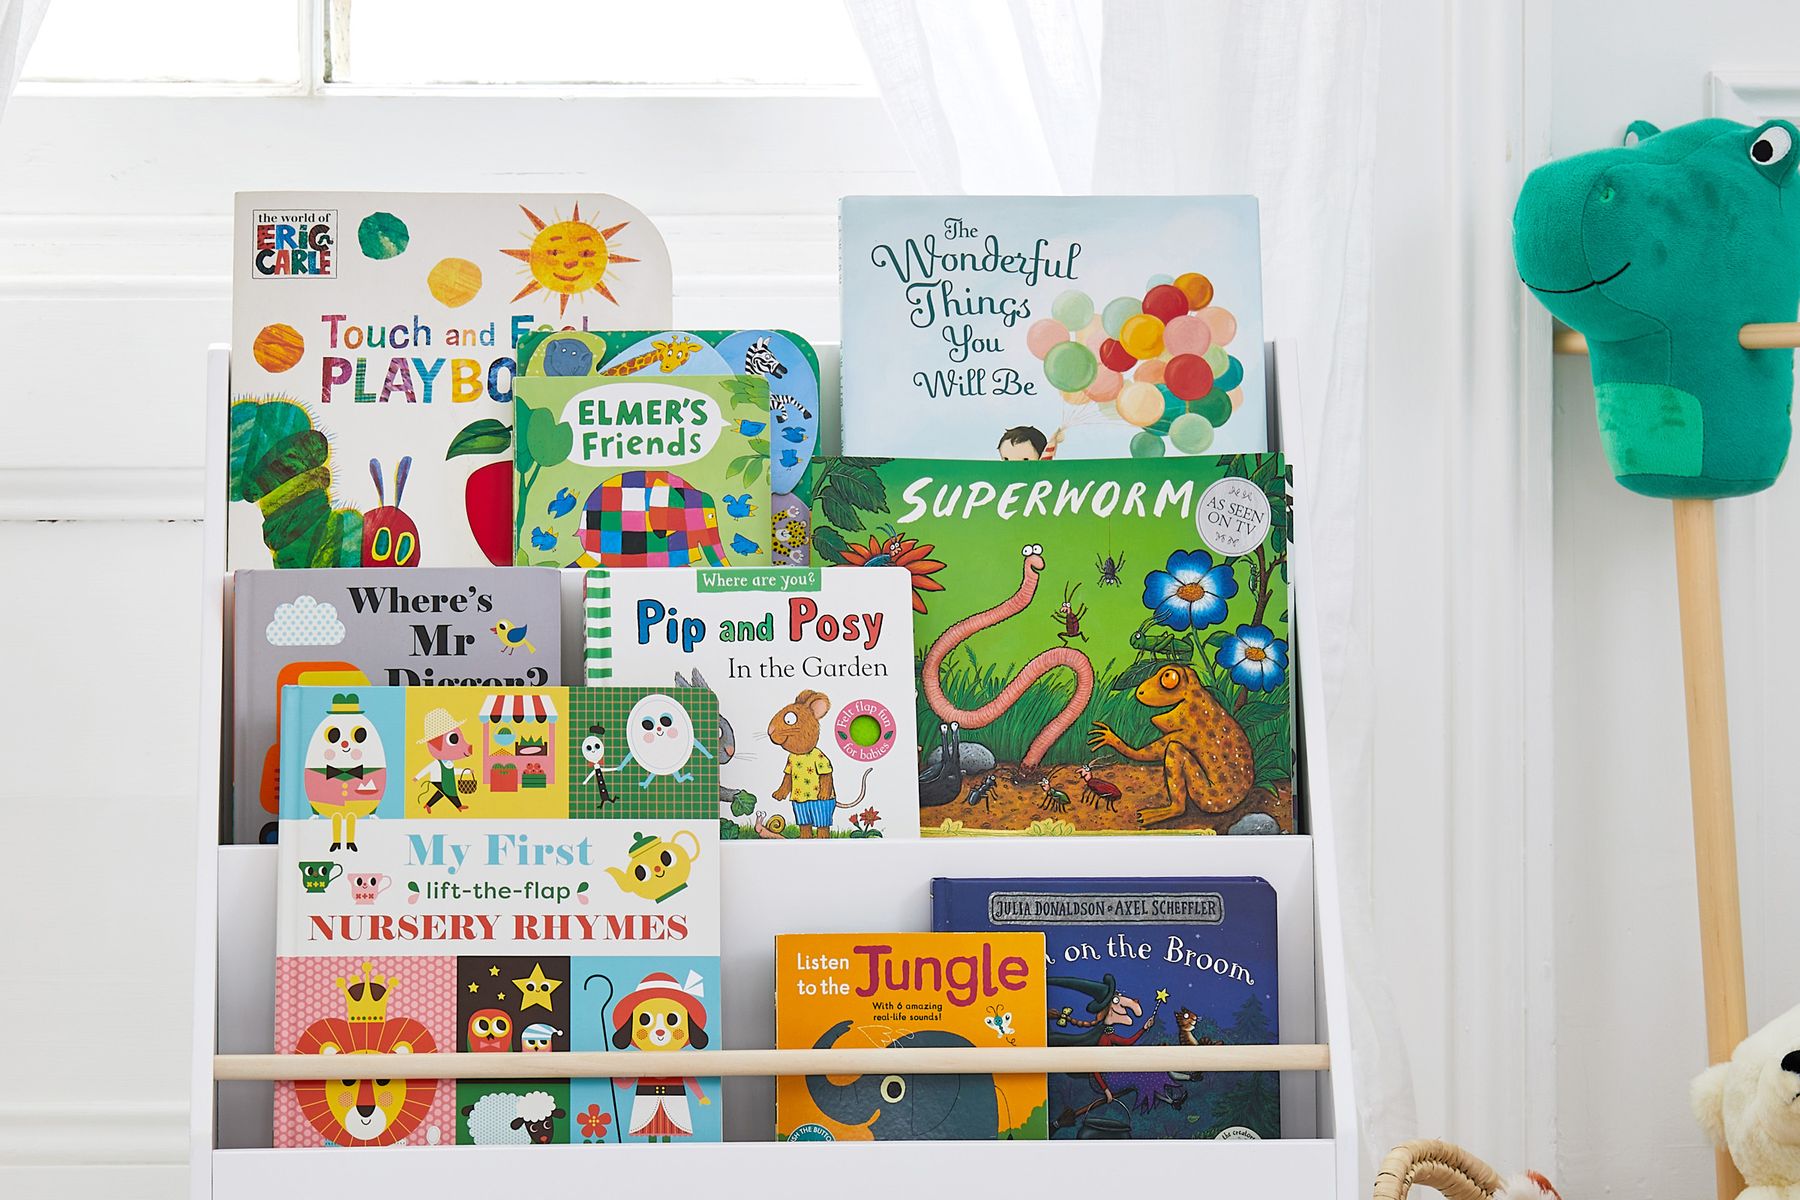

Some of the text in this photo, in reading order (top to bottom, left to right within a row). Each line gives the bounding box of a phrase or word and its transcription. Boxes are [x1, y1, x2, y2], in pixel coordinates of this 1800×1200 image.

[259, 213, 331, 222] the world of
[944, 217, 978, 240] The
[256, 249, 330, 275] CARLE
[871, 235, 1081, 286] Wonderful
[906, 279, 1031, 328] Things
[321, 315, 431, 349] Touch
[445, 322, 495, 346] and
[942, 325, 1004, 363] You
[913, 368, 1037, 398] Will Be
[579, 398, 708, 426] ELMER'S
[582, 427, 701, 460] Friends
[897, 477, 1194, 524] SUPERWORM
[1207, 497, 1264, 523] AS SEEN
[1208, 511, 1256, 535] ON TV
[702, 572, 816, 590] Where are you?
[347, 586, 493, 613] Where's
[637, 597, 884, 653] Pip and Posy
[409, 624, 475, 656] Mr
[728, 655, 889, 678] In the Garden
[837, 701, 891, 728] Felt flap fun
[844, 743, 890, 759] for babies
[404, 833, 595, 875] My First
[426, 881, 571, 904] lift-the-flap
[996, 899, 1217, 918] JULIA DONALDSON AXEL SCHEFFLER
[308, 914, 689, 941] NURSERY RHYMES
[797, 953, 849, 970] Listen
[1065, 943, 1101, 962] on
[1107, 934, 1151, 959] the
[1164, 935, 1255, 986] Broom
[797, 977, 850, 995] to the
[853, 942, 1029, 1007] Jungle
[872, 1002, 943, 1013] With 6 amazing
[873, 1013, 942, 1022] real-life sounds!
[799, 1126, 812, 1134] THE
[813, 1126, 832, 1142] BUTTO
